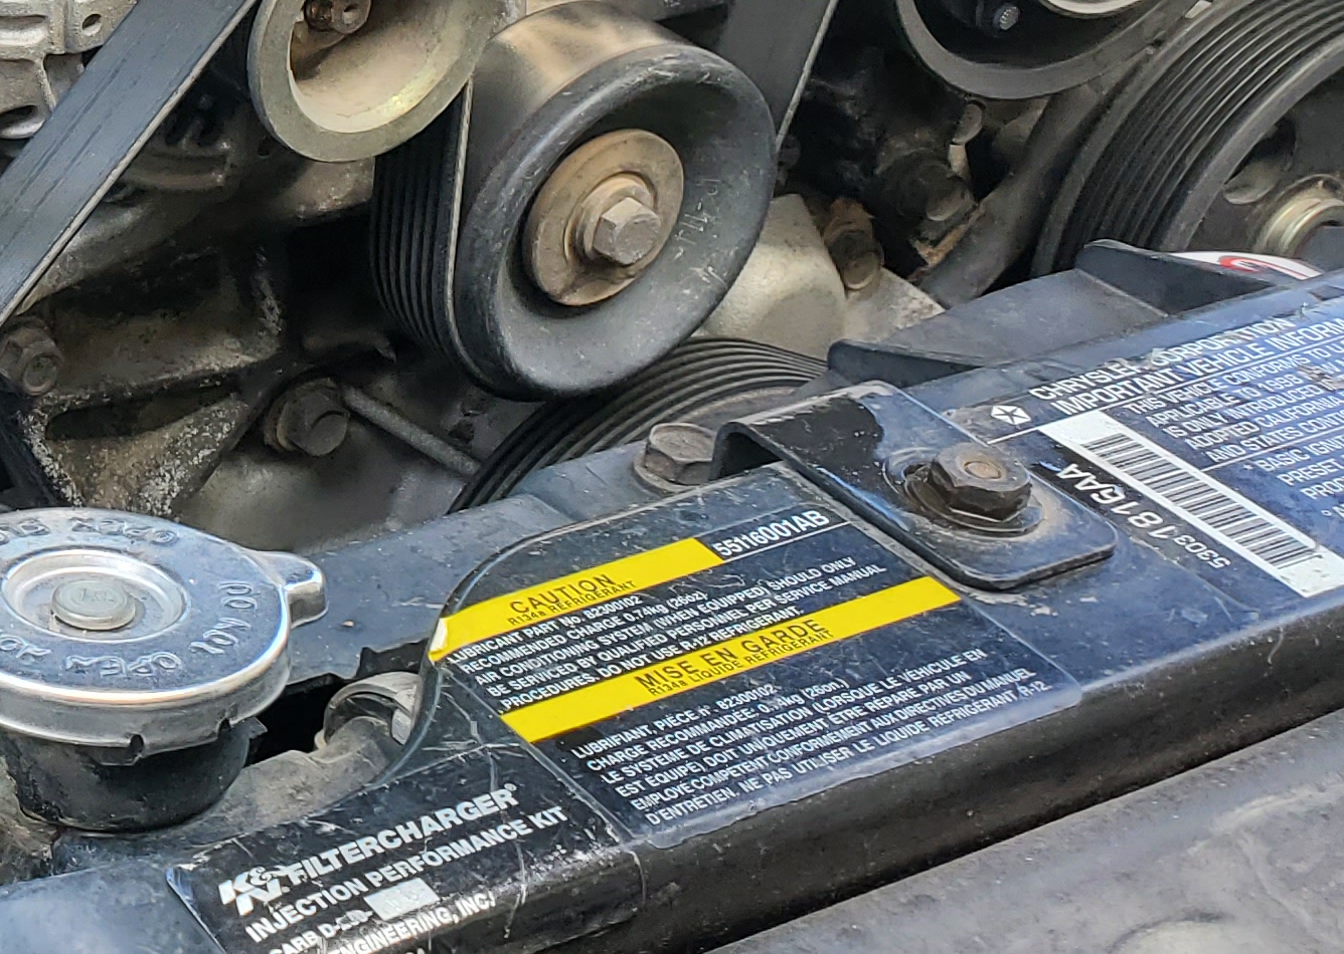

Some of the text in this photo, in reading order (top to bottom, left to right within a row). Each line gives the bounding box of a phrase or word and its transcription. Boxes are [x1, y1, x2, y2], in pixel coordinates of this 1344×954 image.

[1052, 368, 1182, 414] IMPORTANT
[1188, 343, 1274, 377] VEHICLE
[1123, 354, 1310, 414] THIS VEHICLE CONFORMS
[1146, 374, 1304, 426] APPLICABLE TO 1998
[1162, 385, 1324, 438] IS ONLY INTRODUCED
[1185, 396, 1344, 449] ADOPTED CALIFORNIA
[1206, 426, 1304, 462] AND STATES
[1254, 449, 1310, 471] BASIC
[1277, 460, 1344, 485] PRESET
[713, 511, 829, 555] 55116001AB
[510, 574, 615, 613] CAUTION
[546, 580, 636, 613] REFRIGERANT
[443, 632, 523, 664] LUBRICANT
[522, 620, 559, 638] PART
[558, 616, 586, 627] No.
[459, 635, 567, 673] RECOMMENDED
[566, 616, 625, 639] CHARGE
[623, 604, 669, 622] 0.74kg
[475, 671, 502, 685] AIR
[597, 622, 654, 645] SYSTEM
[767, 568, 822, 590] SHOULD
[820, 557, 856, 573] ONLY
[66, 653, 182, 677] OPEN
[634, 619, 825, 689] MISE EN GARDE
[283, 788, 516, 883] FILTERCHARGER
[243, 879, 376, 942] INJECTION
[367, 820, 531, 886] PERFORMANCE
[529, 806, 567, 829] KIT
